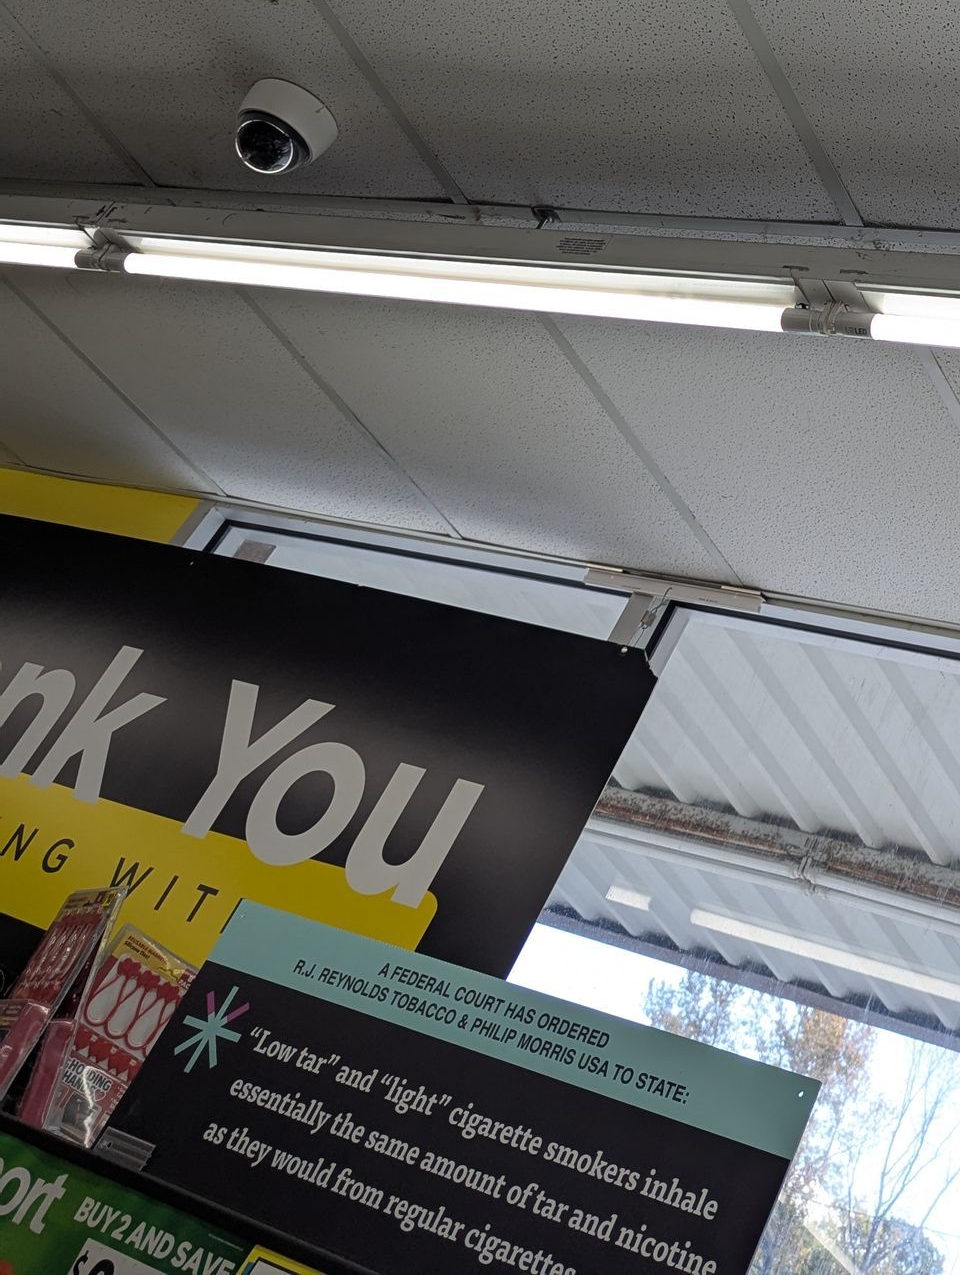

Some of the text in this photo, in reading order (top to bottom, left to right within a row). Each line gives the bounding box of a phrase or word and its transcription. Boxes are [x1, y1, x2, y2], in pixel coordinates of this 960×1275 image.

[0, 644, 486, 909] nk You
[0, 815, 75, 874] NG
[292, 959, 690, 1104] R.J. REYNOLDS TOBACCO & PHILIP MORRIS USA TO STATE:
[377, 962, 610, 1049] A FEDERAL COURT HAS ORDERED
[67, 1059, 112, 1091] HODING
[249, 1026, 719, 1220] “Low tar” and “light” cigarette smokers inhale
[0, 1157, 69, 1235] ort
[73, 1196, 114, 1233] BUY
[111, 1215, 132, 1241] 2
[124, 1221, 175, 1260] AND
[202, 1122, 228, 1145] as
[225, 1127, 272, 1168] they
[270, 1148, 337, 1189] would
[330, 1168, 385, 1210] from
[382, 1194, 466, 1242] regular
[229, 1078, 718, 1275] essentially the same amount of tar and nicotine
